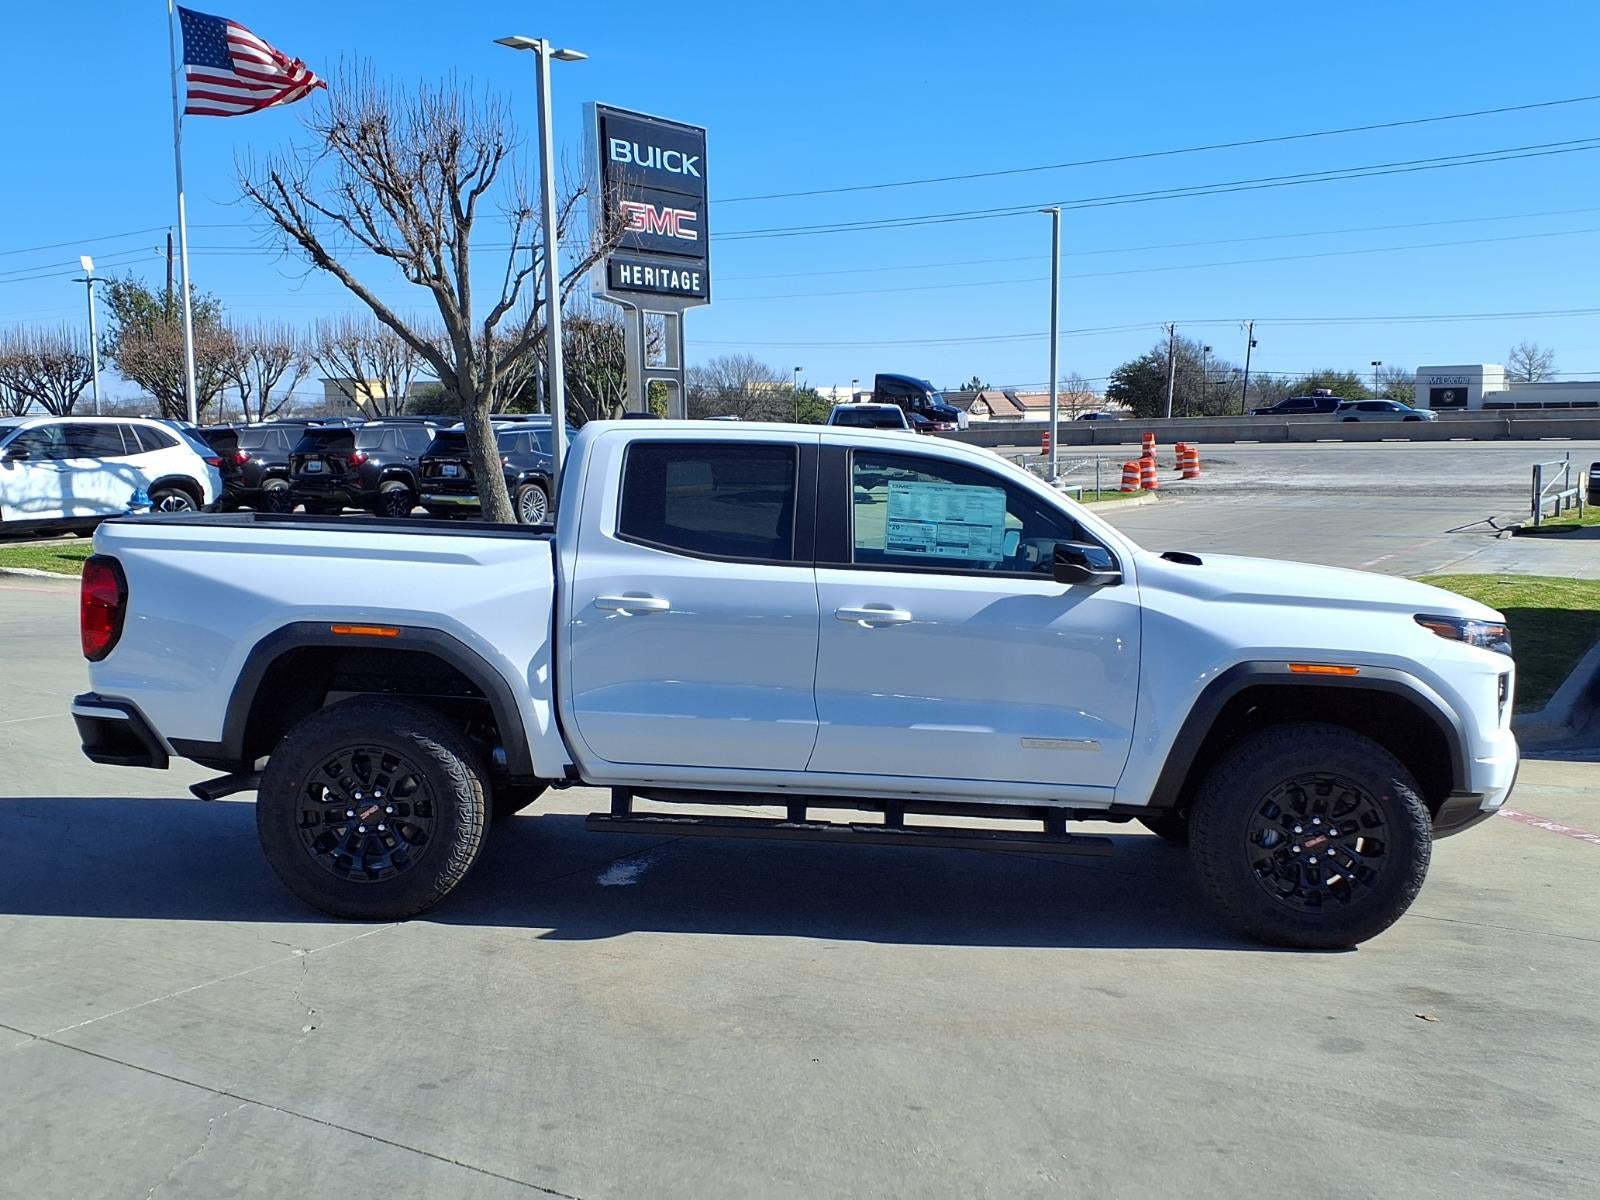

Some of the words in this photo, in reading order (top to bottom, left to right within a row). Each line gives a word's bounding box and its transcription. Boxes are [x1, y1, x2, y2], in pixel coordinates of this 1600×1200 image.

[609, 137, 701, 178] BUICK
[619, 200, 698, 241] GMC
[620, 264, 700, 291] HERITAGE
